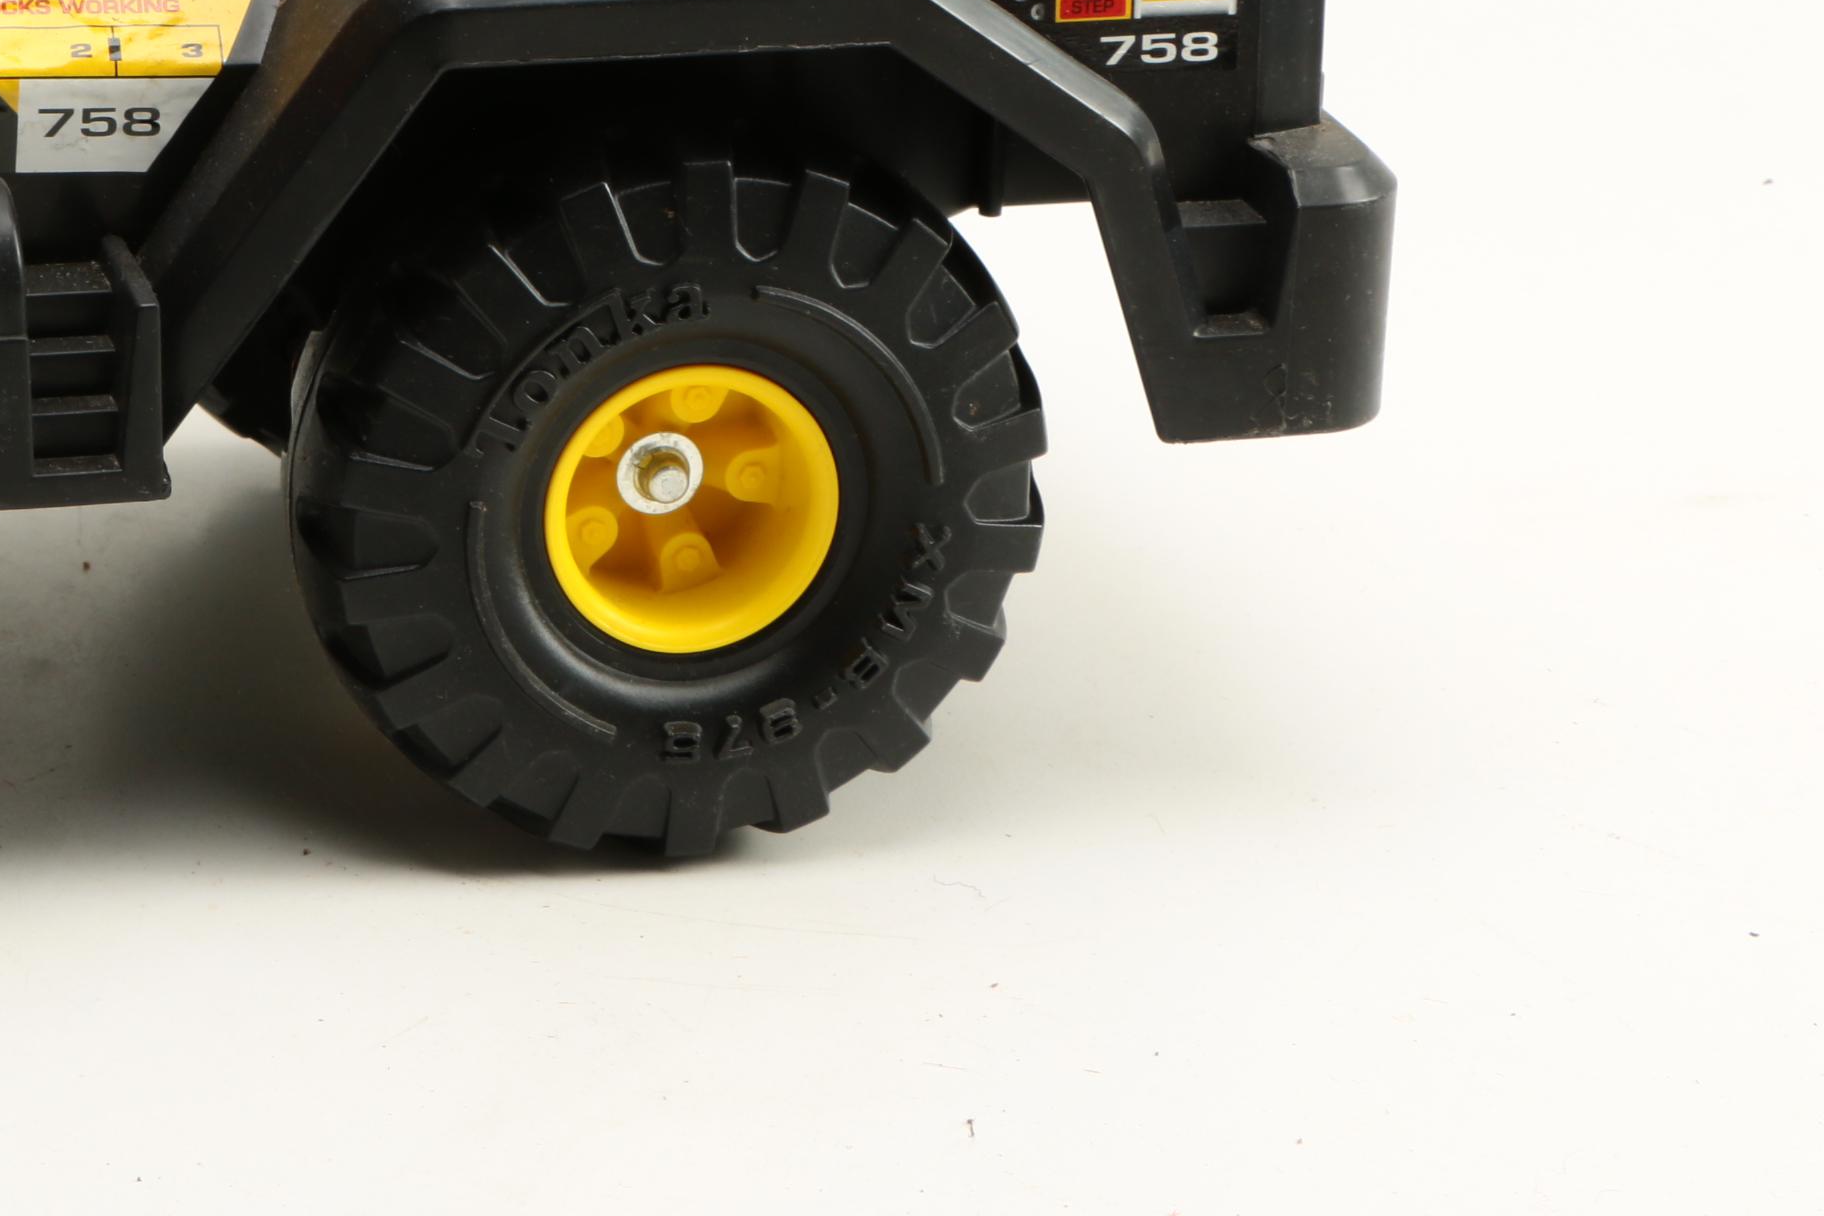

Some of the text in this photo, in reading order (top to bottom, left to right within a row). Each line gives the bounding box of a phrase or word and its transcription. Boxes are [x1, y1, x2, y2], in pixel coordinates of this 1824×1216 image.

[69, 42, 94, 60] 2
[180, 42, 205, 60] 3
[1099, 30, 1220, 67] 758
[37, 106, 163, 139] 758
[463, 282, 711, 459] Tonka
